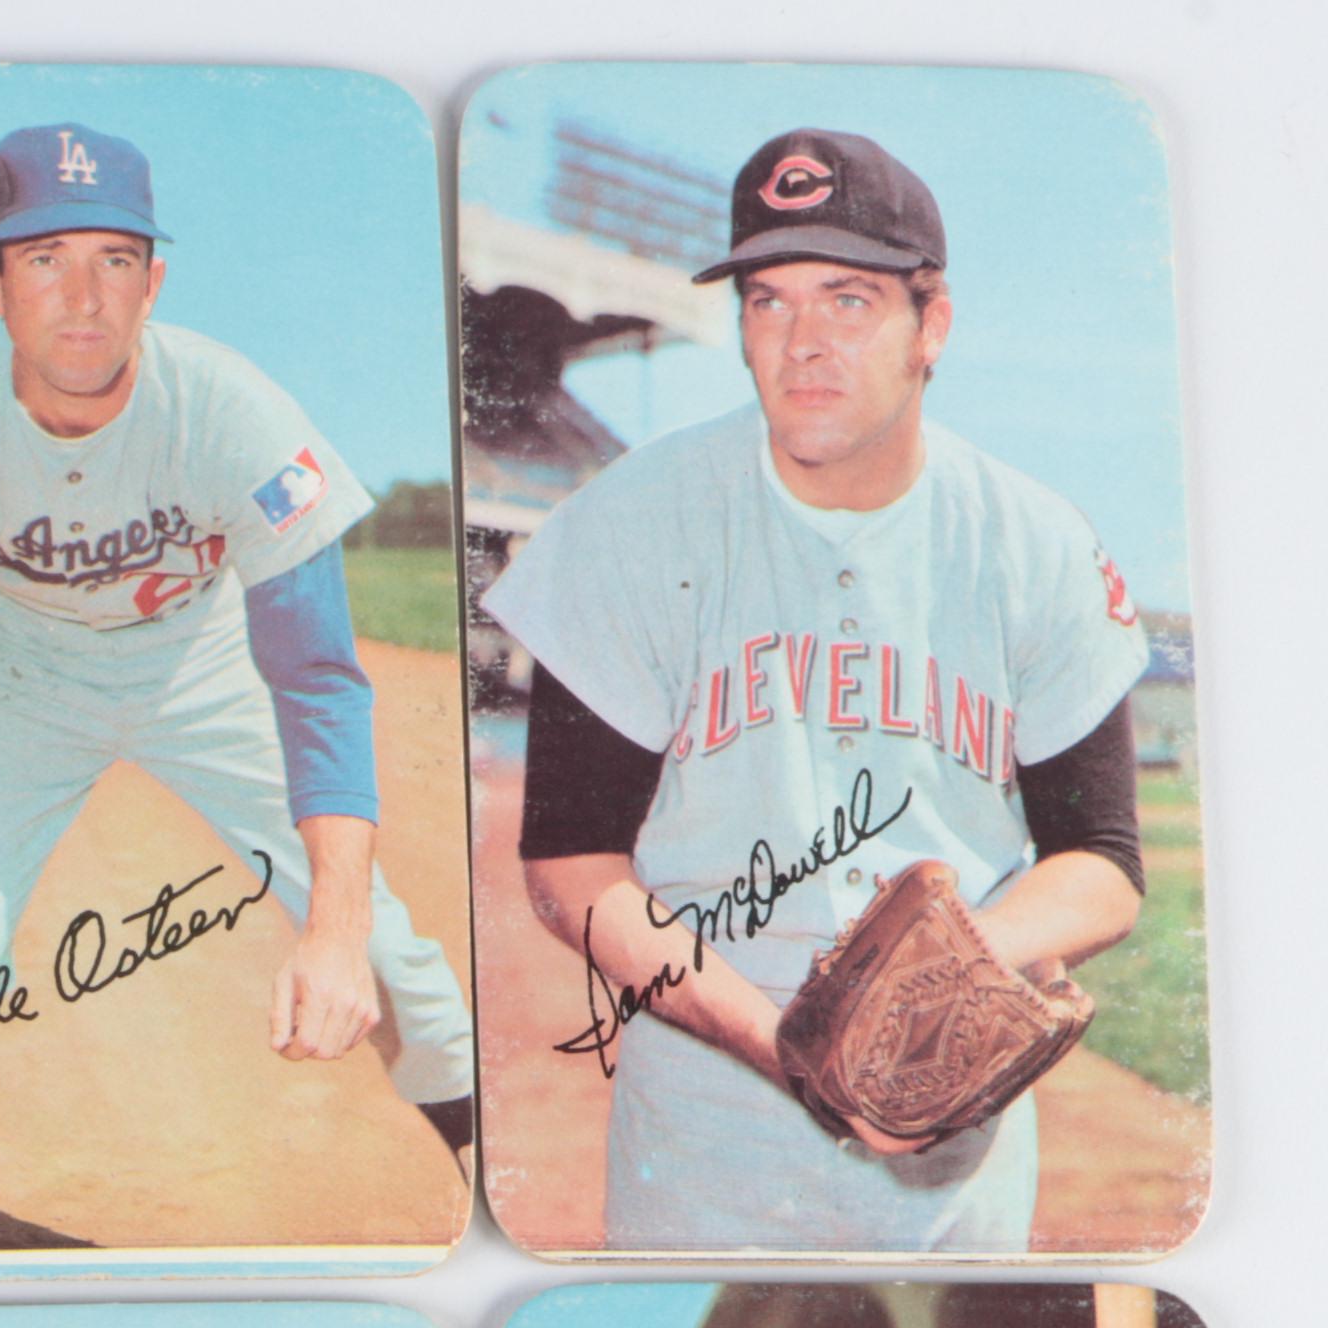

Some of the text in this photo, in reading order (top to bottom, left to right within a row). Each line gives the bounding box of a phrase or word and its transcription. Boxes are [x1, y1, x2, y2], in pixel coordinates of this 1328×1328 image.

[57, 131, 97, 185] LA
[54, 849, 272, 1002] Osteen
[553, 905, 686, 1079] Sam
